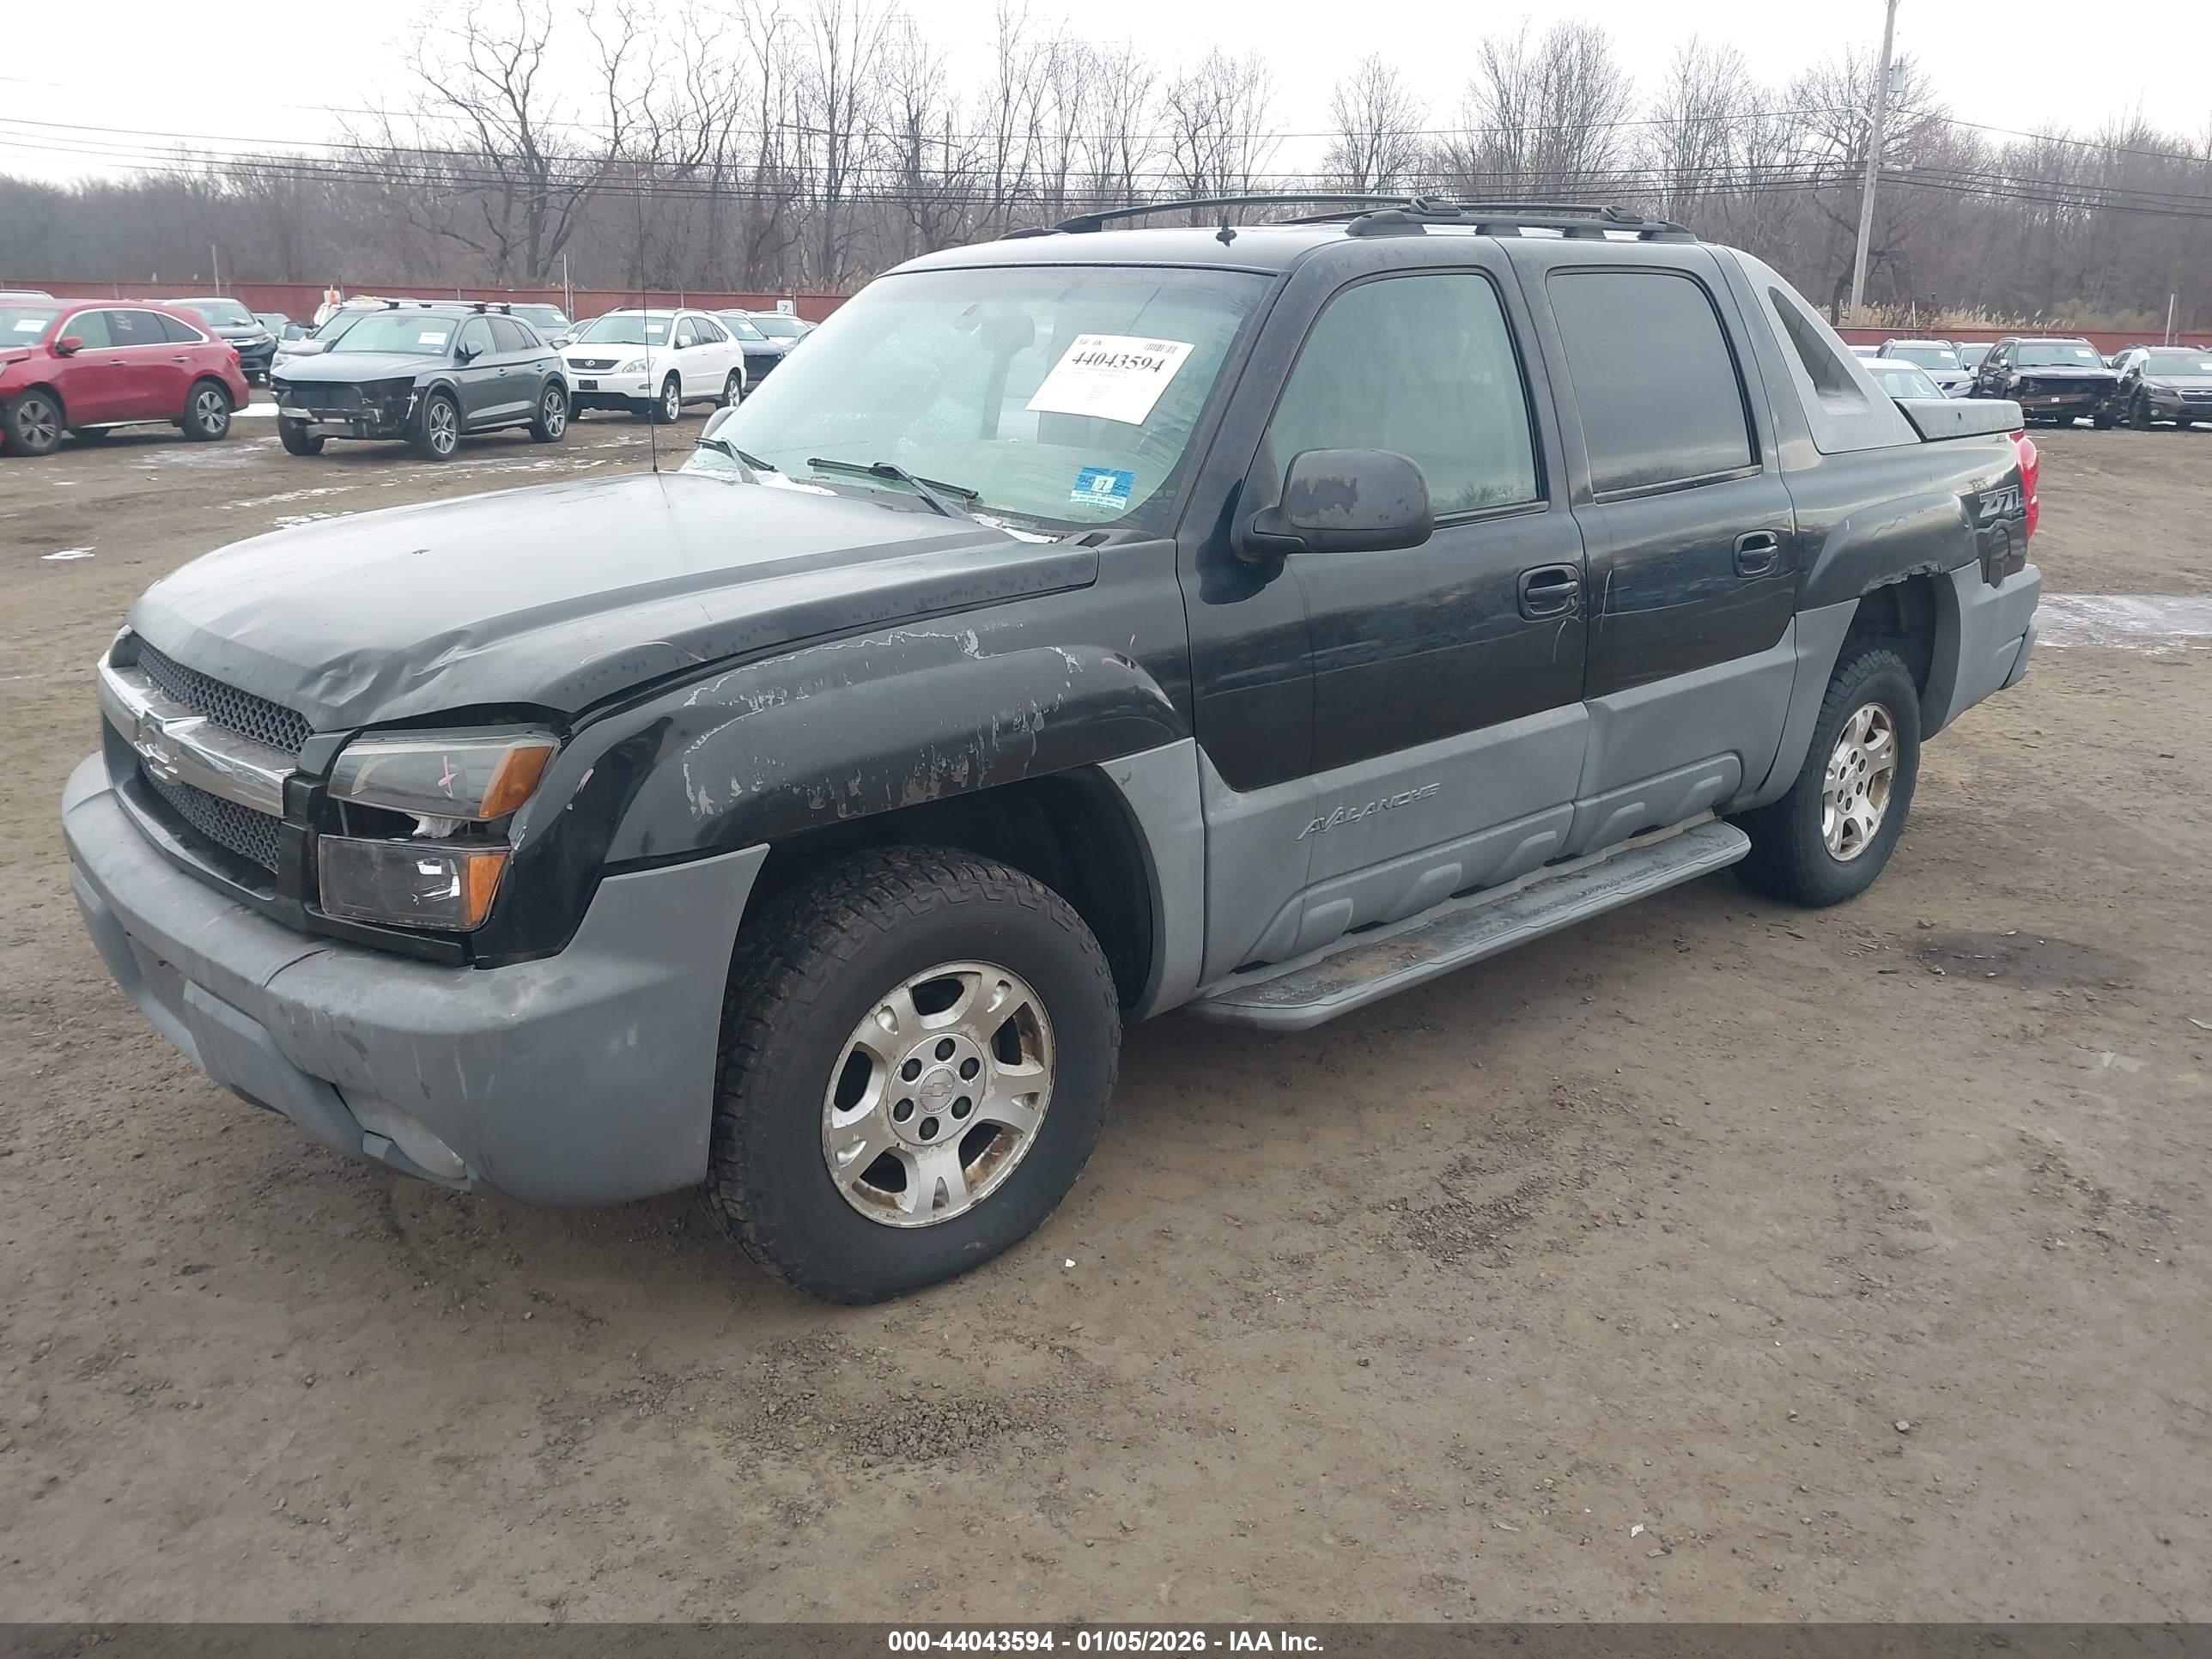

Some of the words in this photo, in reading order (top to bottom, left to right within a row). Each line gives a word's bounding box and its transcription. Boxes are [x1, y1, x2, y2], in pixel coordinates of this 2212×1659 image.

[782, 304, 788, 313] 7
[1072, 351, 1166, 373] 44043594
[1978, 483, 2020, 519] Z71
[1295, 782, 1441, 842] AVALANCHE
